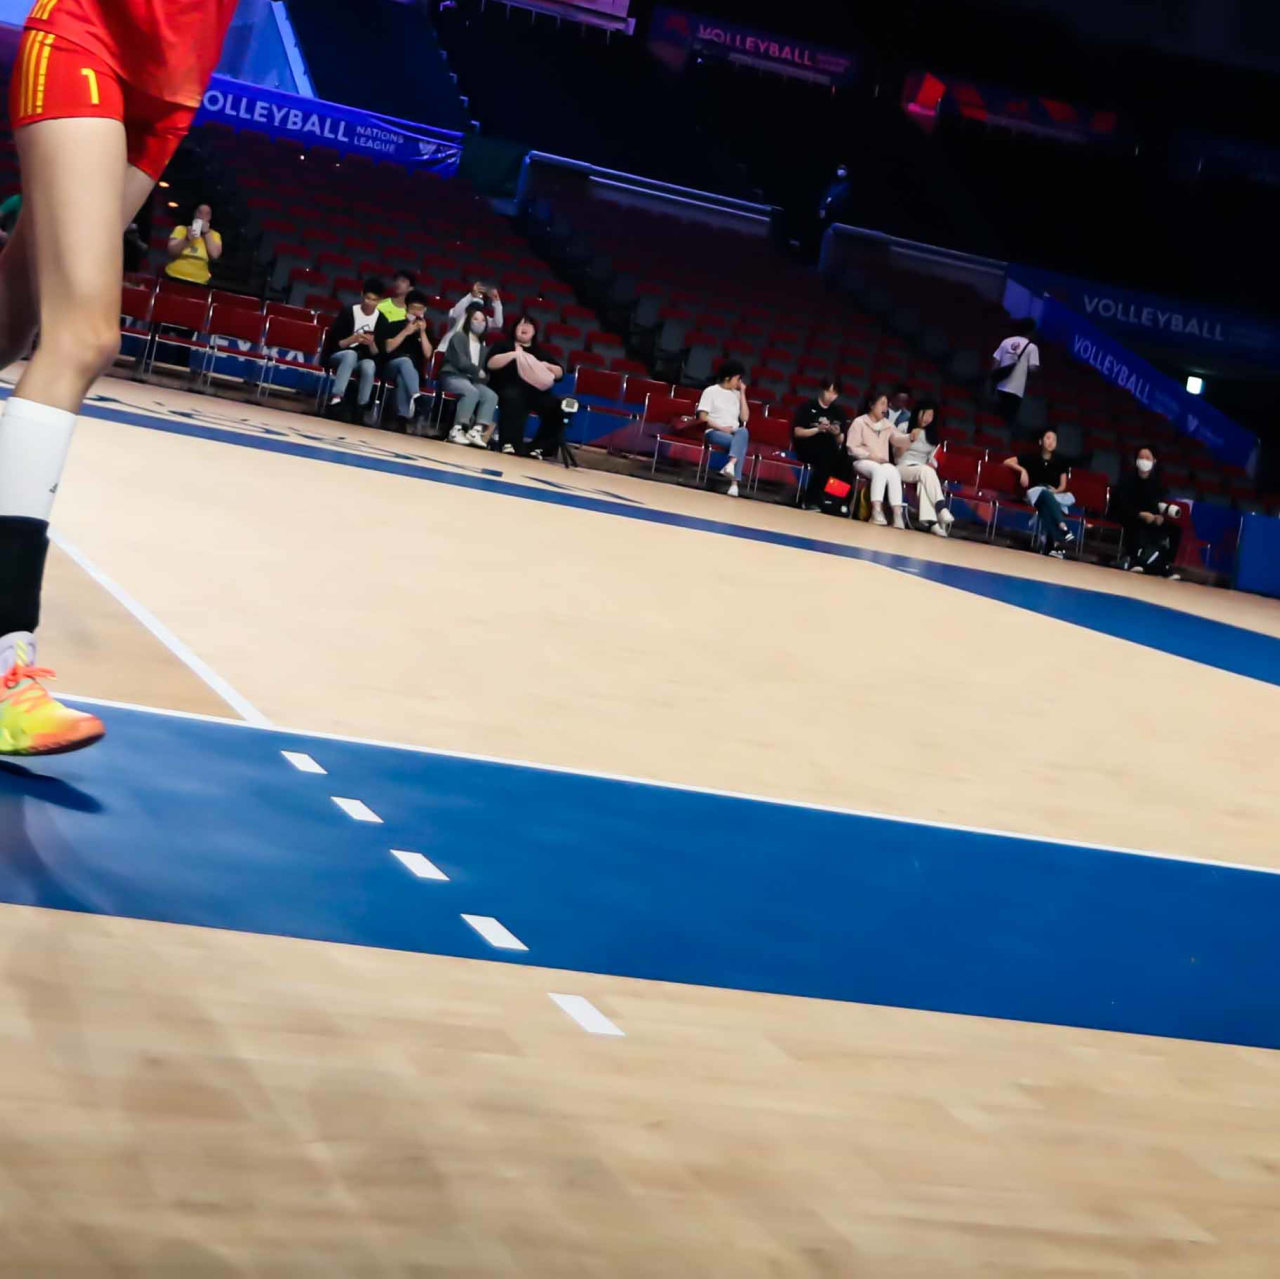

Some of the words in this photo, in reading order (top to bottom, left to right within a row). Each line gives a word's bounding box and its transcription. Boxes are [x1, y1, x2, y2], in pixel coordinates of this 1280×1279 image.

[698, 23, 814, 67] VOLLEYBALL
[81, 67, 100, 105] 1
[202, 90, 350, 142] OLLEYBALL
[355, 125, 405, 144] NATIONS
[353, 136, 396, 154] LEAGUE
[1082, 293, 1225, 342] VOLLEYBALL
[1072, 333, 1152, 406] VOLLEYBALL
